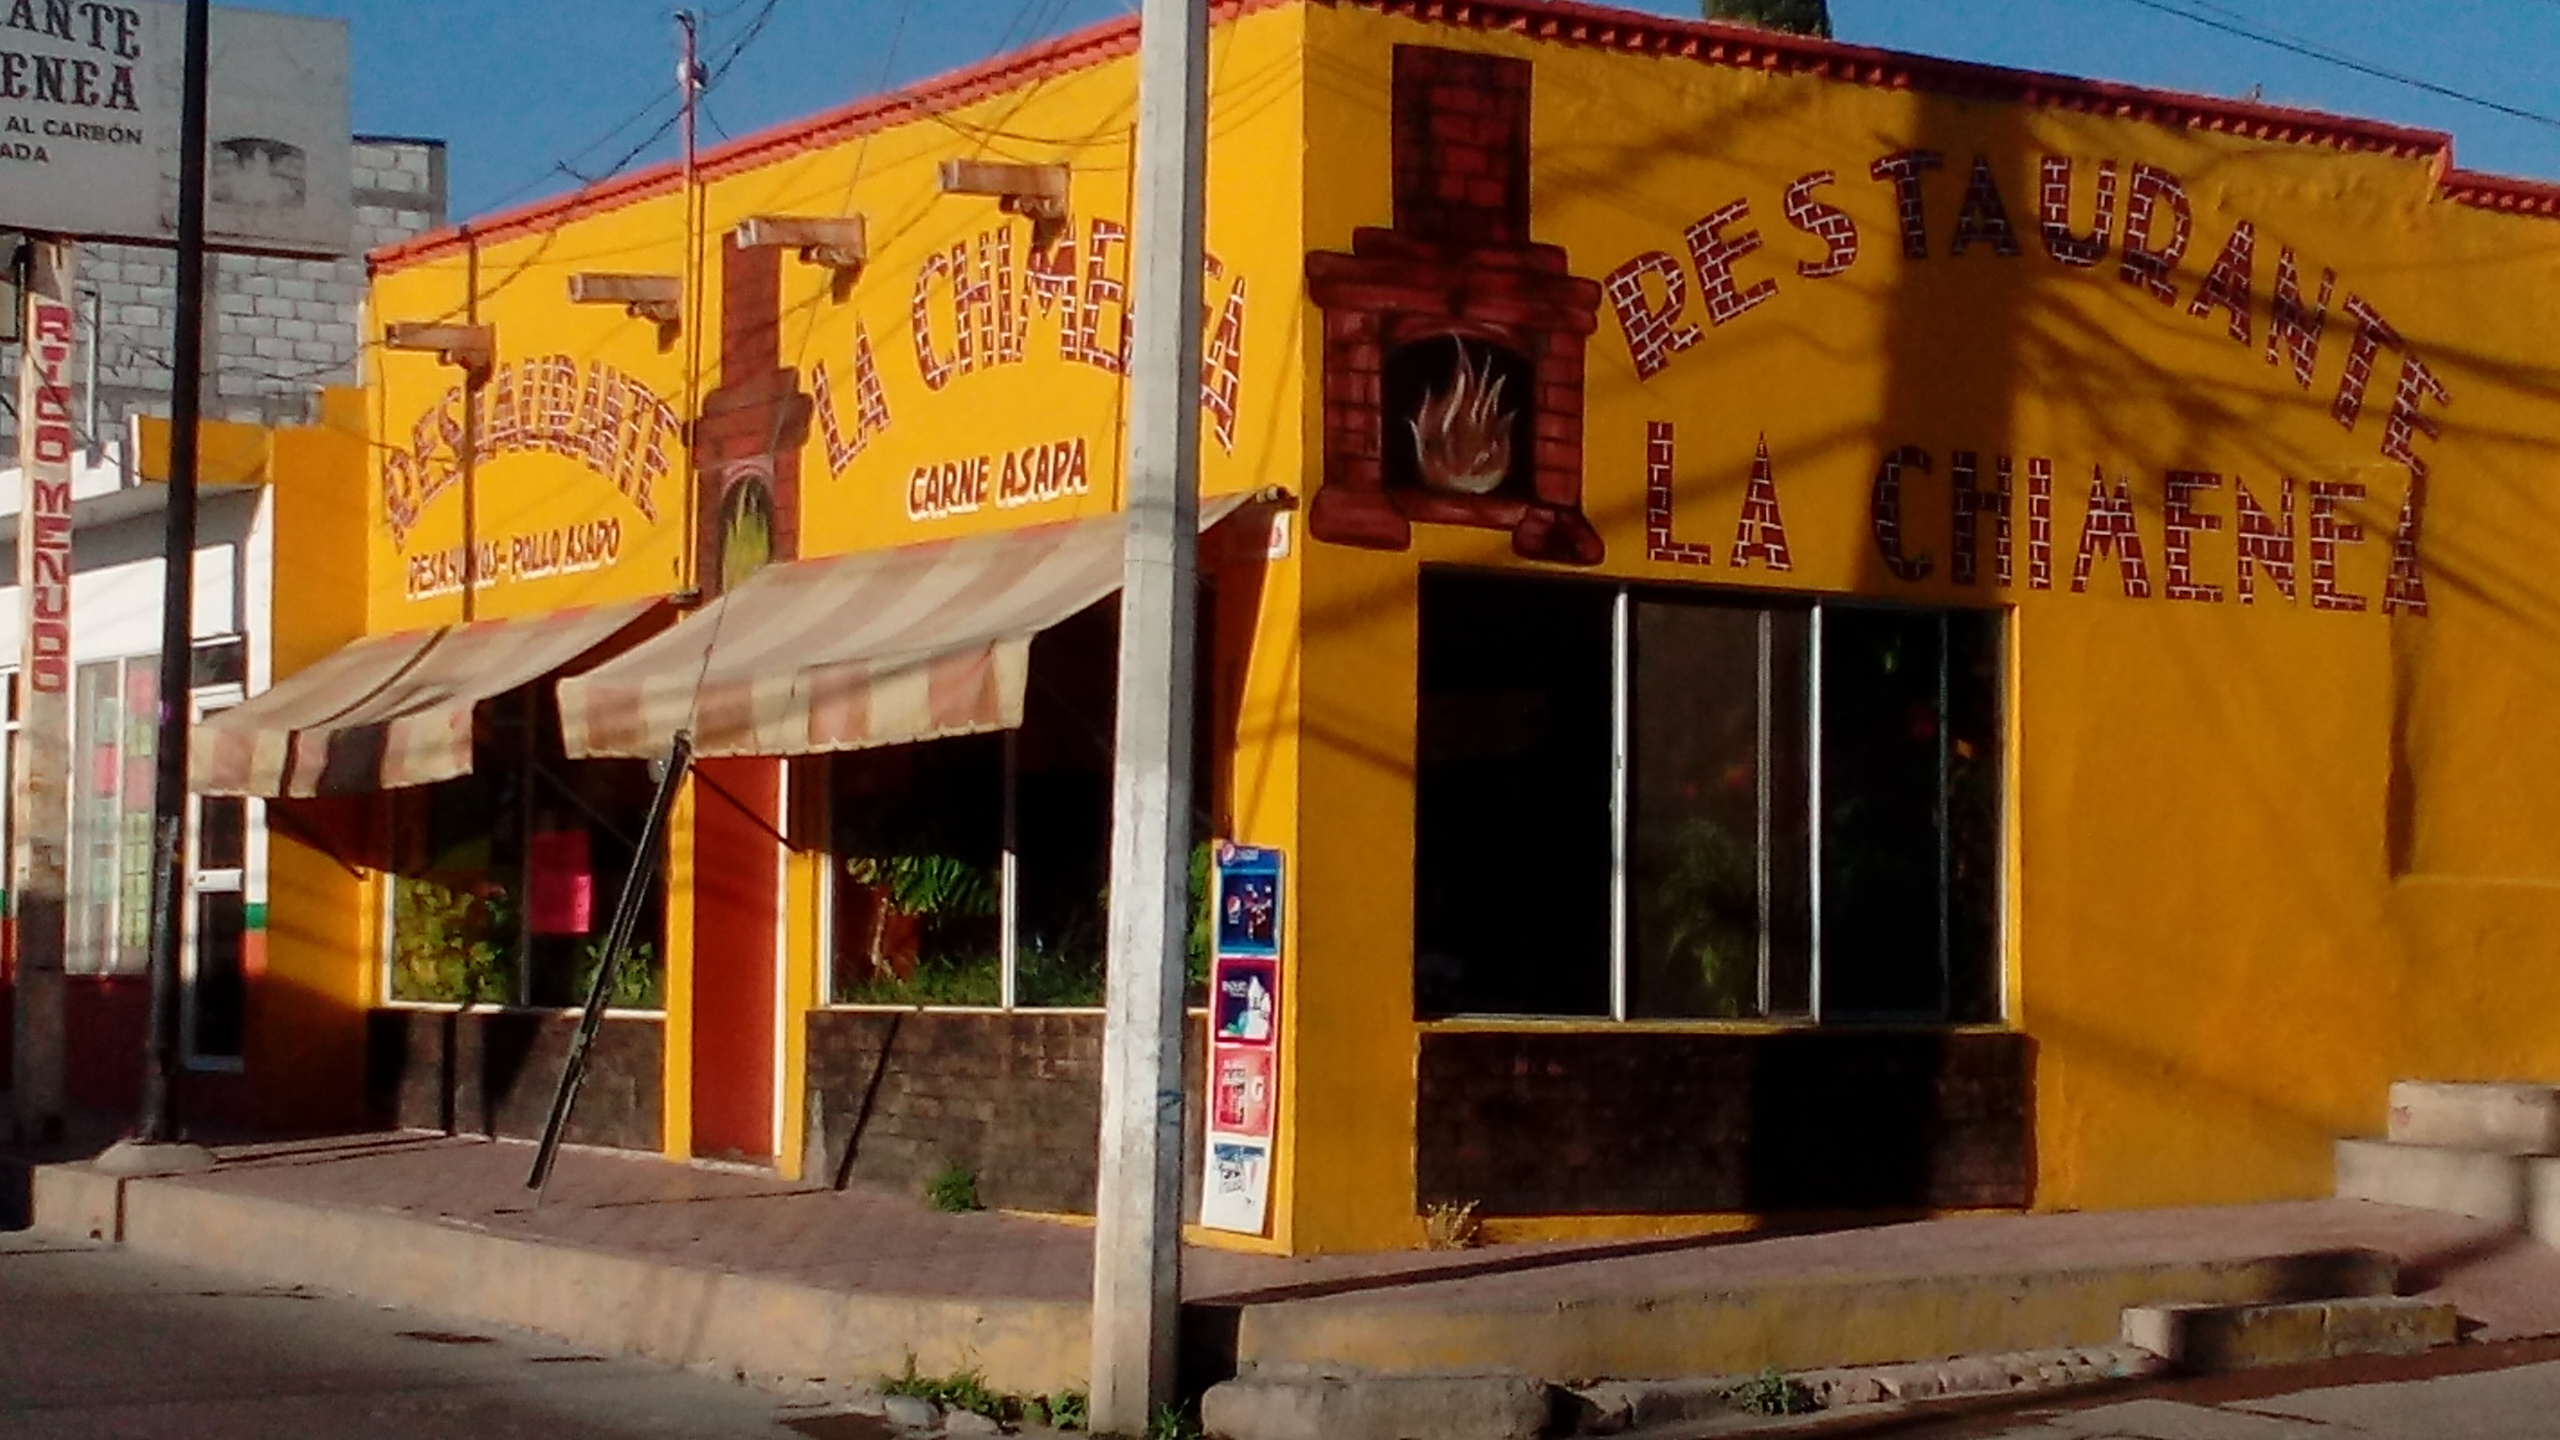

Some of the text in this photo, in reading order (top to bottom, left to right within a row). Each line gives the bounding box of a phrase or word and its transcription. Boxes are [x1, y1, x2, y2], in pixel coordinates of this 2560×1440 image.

[0, 0, 141, 59] ANTE
[0, 51, 140, 112] ENEA
[0, 142, 49, 164] ADA
[5, 115, 35, 134] AL
[1604, 148, 2452, 476] RESTAURANTE
[811, 214, 1247, 482] LA CHIMEA
[908, 454, 991, 520] CARNE
[1646, 420, 2429, 619] LA CHIMENEA
[32, 478, 71, 694] MENUDO
